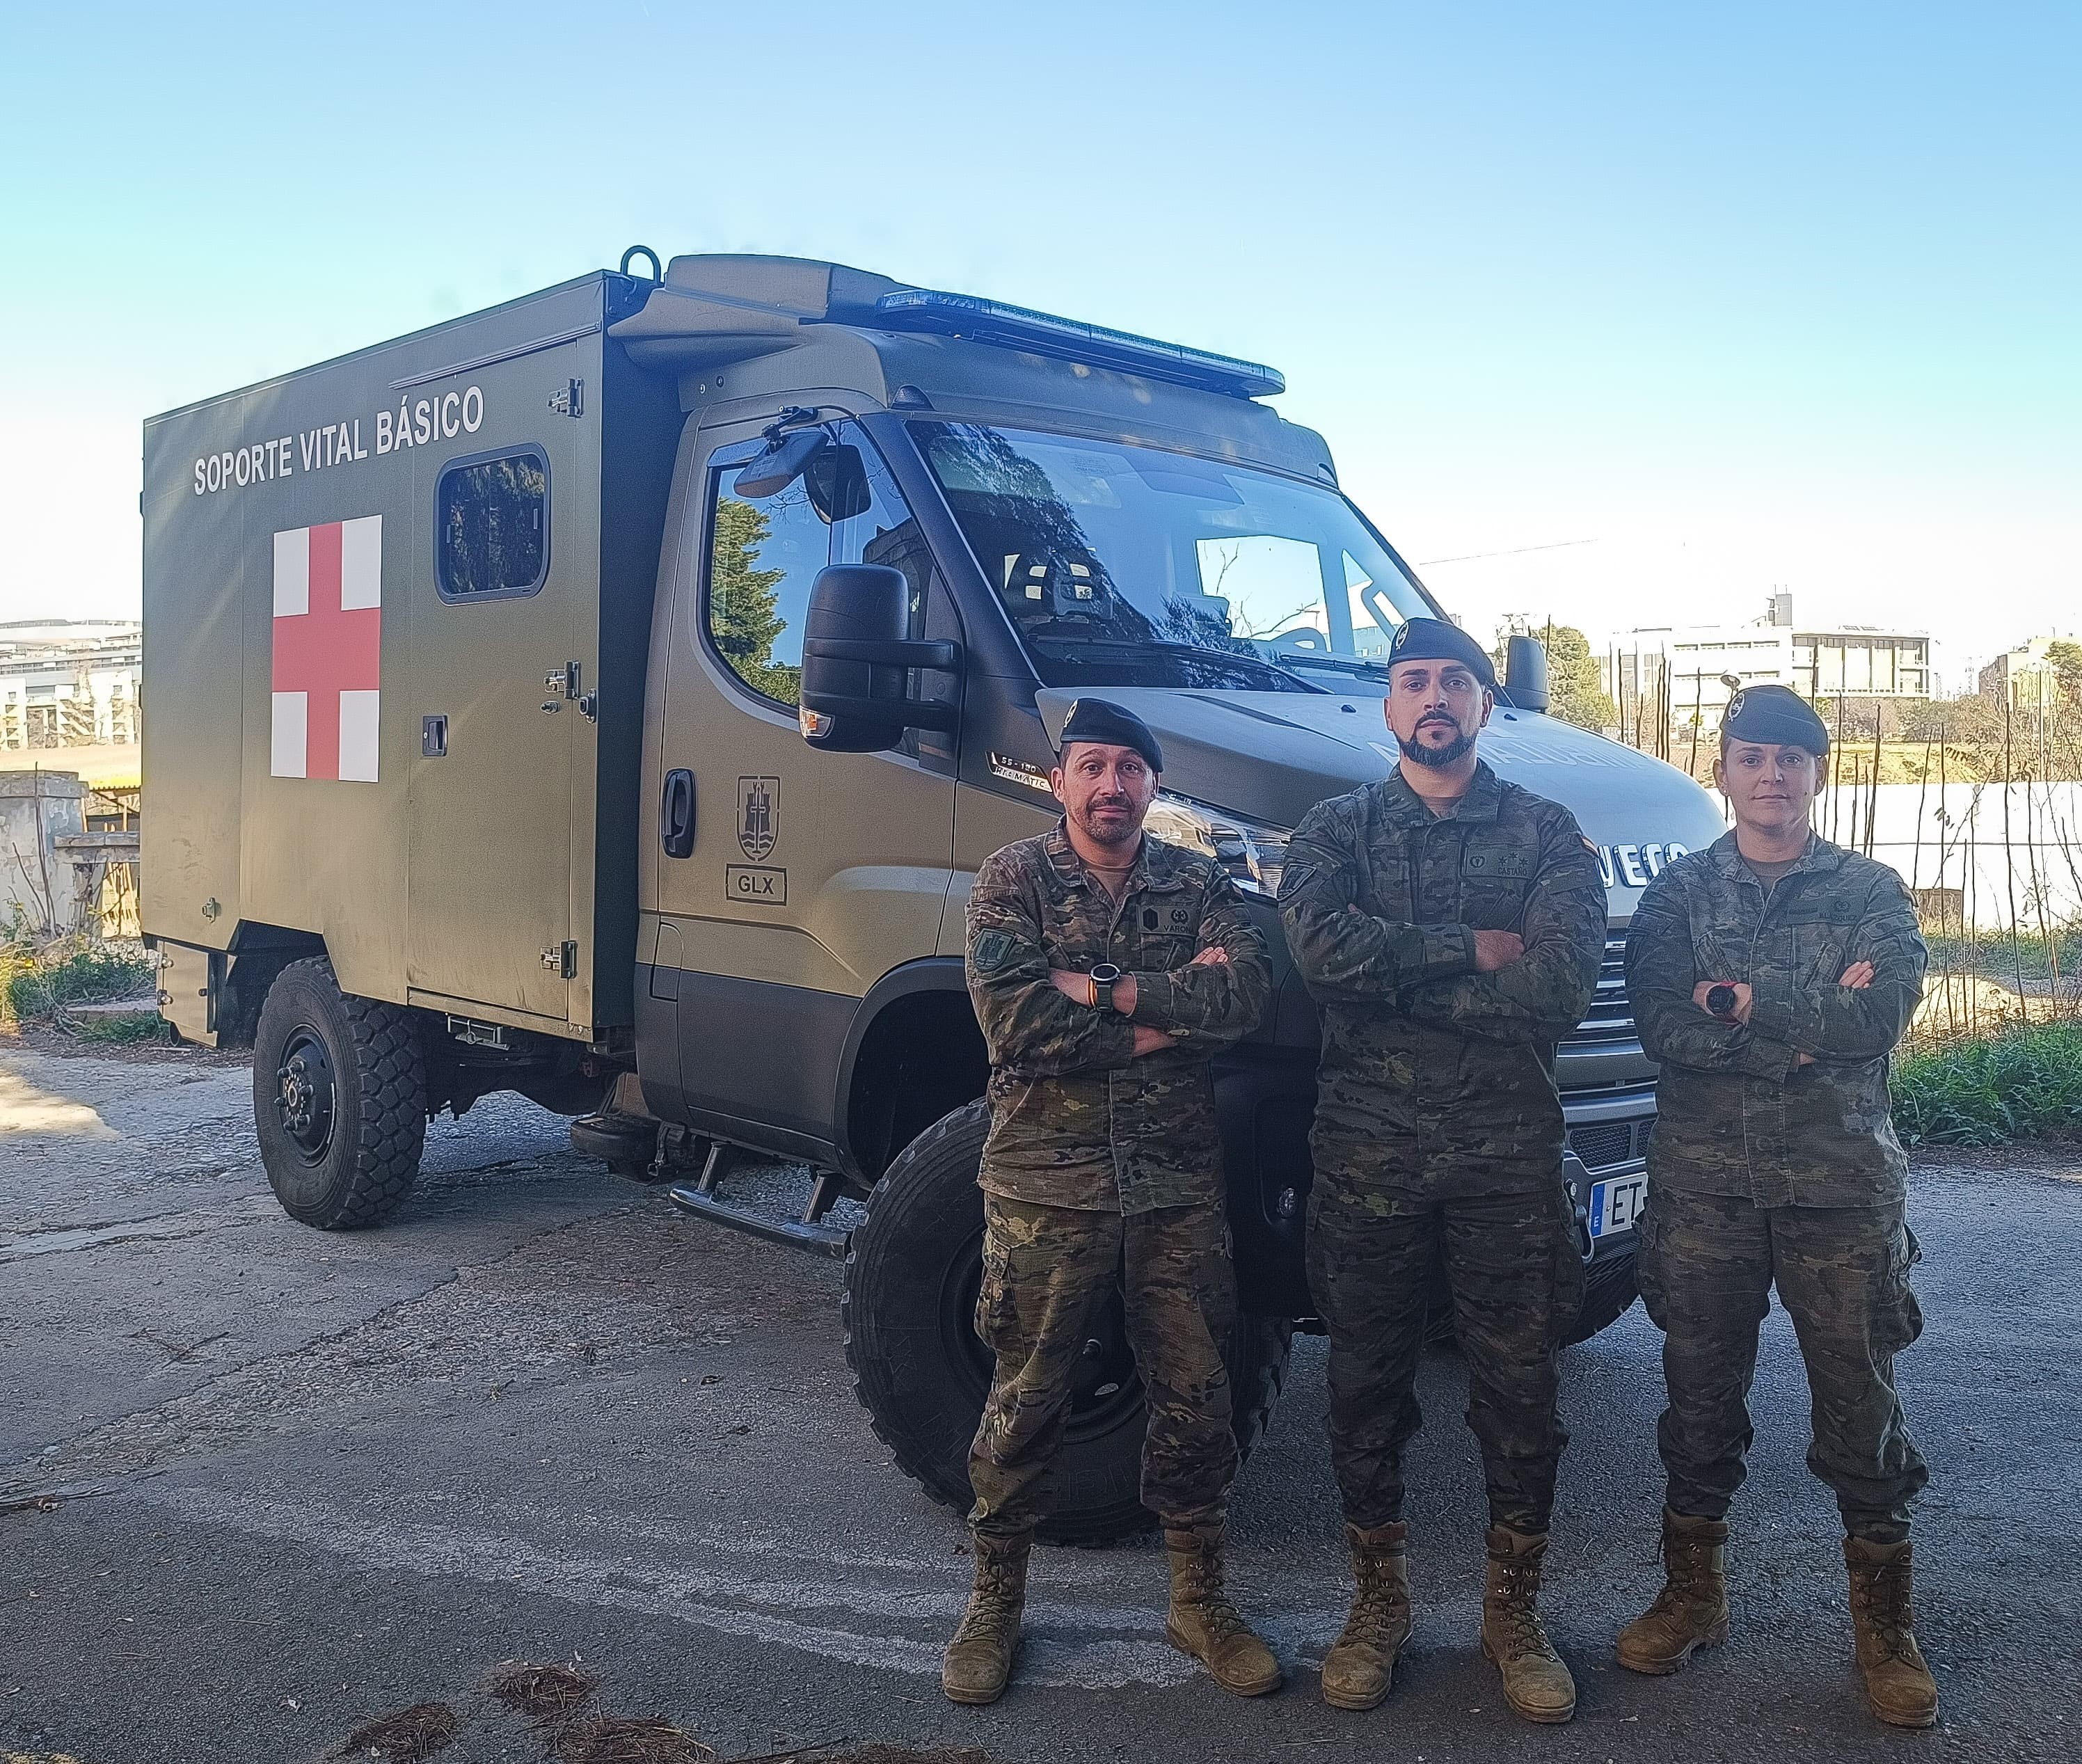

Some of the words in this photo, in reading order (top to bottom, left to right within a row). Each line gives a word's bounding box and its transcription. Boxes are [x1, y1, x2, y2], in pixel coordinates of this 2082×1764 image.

[193, 436, 293, 496] SOPORTE
[299, 418, 369, 472] VITAL
[376, 385, 485, 456] BÁSICO
[1497, 867, 1527, 876] CASTAÑO
[738, 874, 774, 895] GLX
[1611, 1181, 1643, 1227] ET
[1593, 1216, 1600, 1227] E
